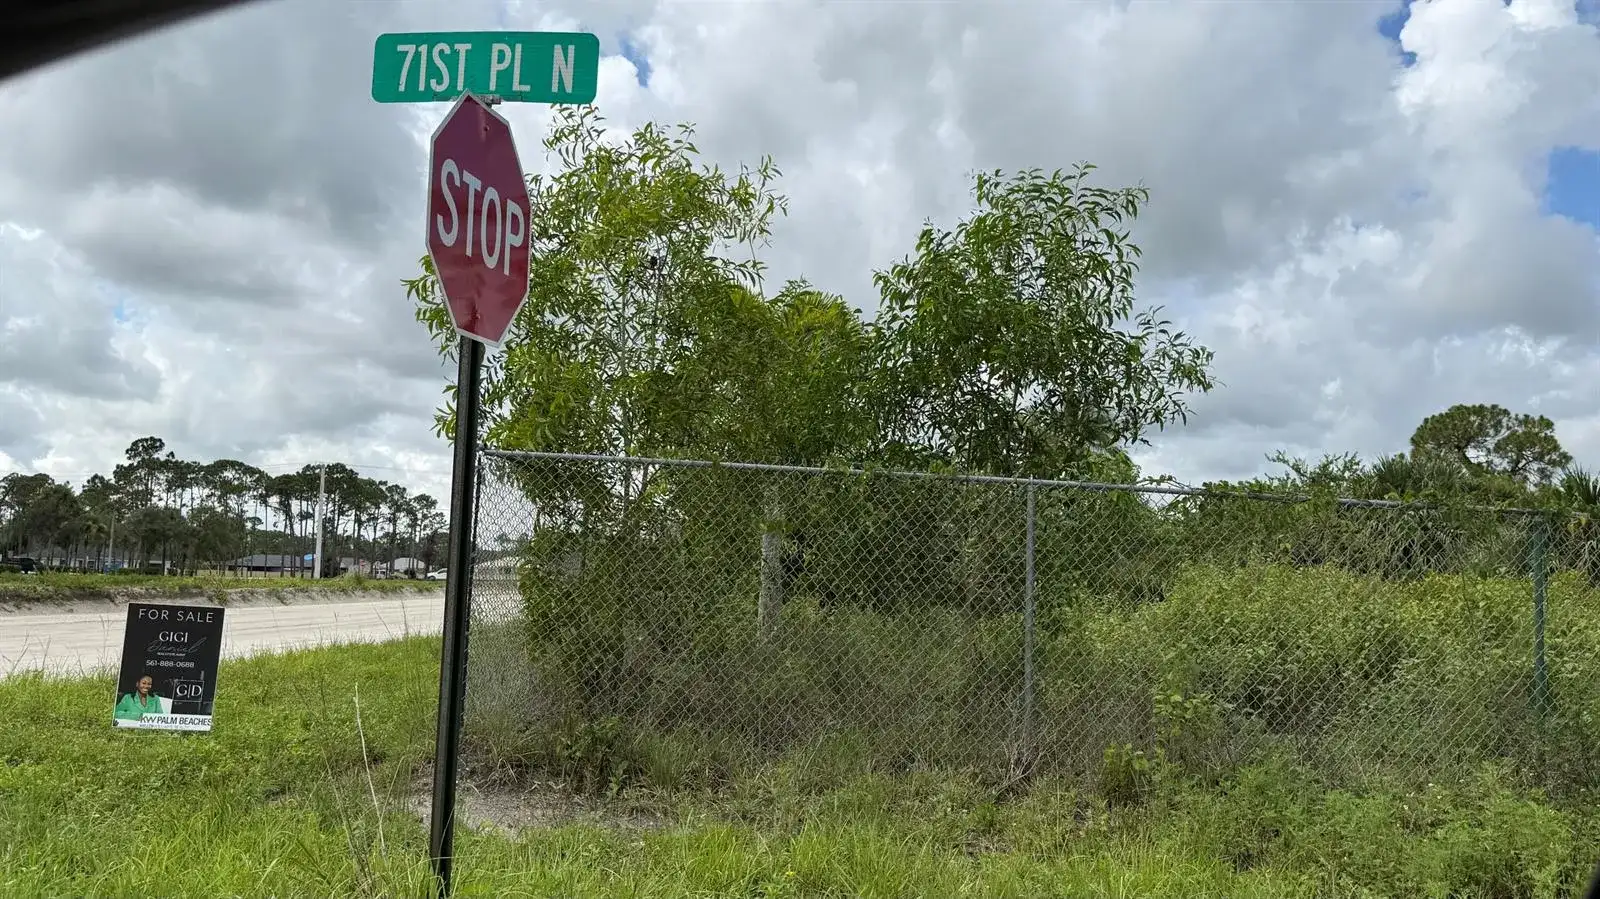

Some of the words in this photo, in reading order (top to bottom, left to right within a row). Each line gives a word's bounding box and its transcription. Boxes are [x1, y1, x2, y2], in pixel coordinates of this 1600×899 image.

[396, 43, 472, 92] 71ST
[489, 43, 531, 92] PL
[551, 44, 575, 94] N
[437, 158, 525, 276] STOP
[138, 608, 169, 621] FOR
[176, 610, 214, 623] SALE
[159, 631, 188, 643] GIGI
[146, 660, 195, 668] 561-888-0688
[140, 715, 157, 723] KW
[157, 716, 178, 725] PALM
[179, 717, 212, 726] BEACHES
